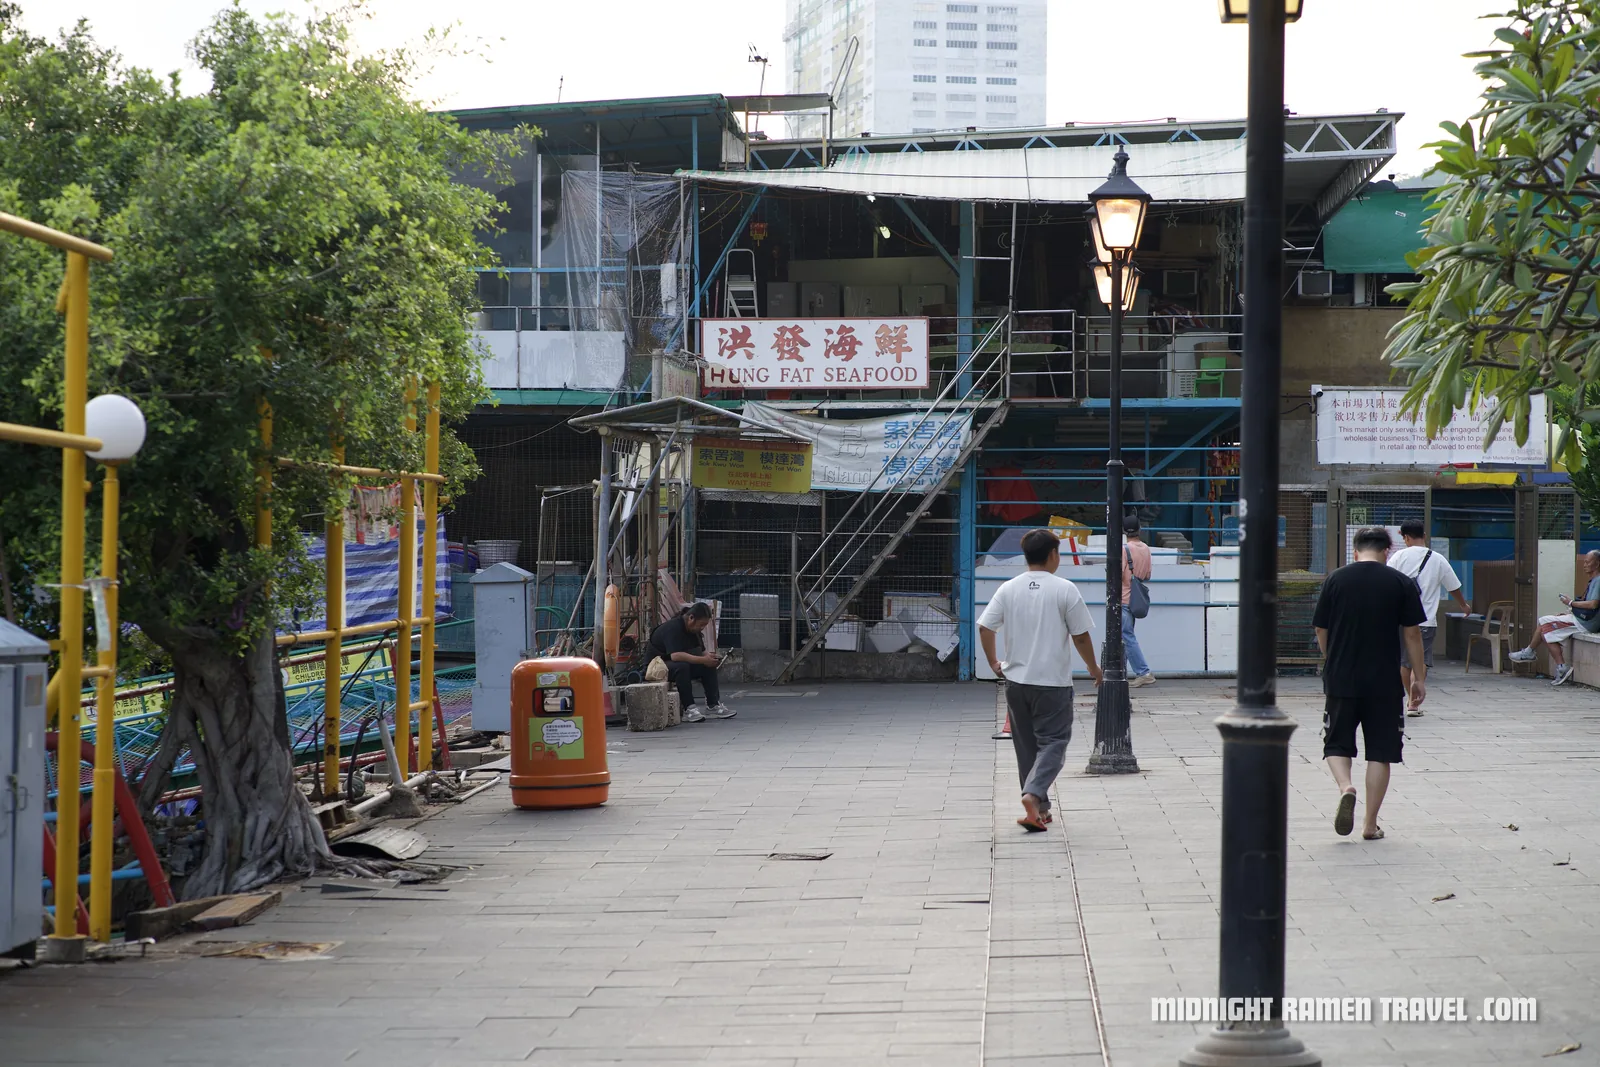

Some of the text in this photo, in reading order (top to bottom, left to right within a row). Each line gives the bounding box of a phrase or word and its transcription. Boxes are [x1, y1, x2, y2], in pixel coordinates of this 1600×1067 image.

[718, 324, 912, 363] 洪發海鮮
[711, 366, 917, 383] HUNG FAT SEAFOOD
[884, 420, 961, 441] 索罟灣
[1379, 426, 1393, 434] only
[1450, 426, 1479, 434] engaged
[884, 440, 901, 449] Sok
[908, 441, 932, 449] Kwu
[699, 448, 744, 463] 索罟灣
[760, 451, 804, 467] 模達灣
[820, 465, 873, 485] Island
[886, 476, 900, 486] Mo
[727, 479, 772, 488] WAIT HERE
[295, 670, 325, 680] CHILDRE
